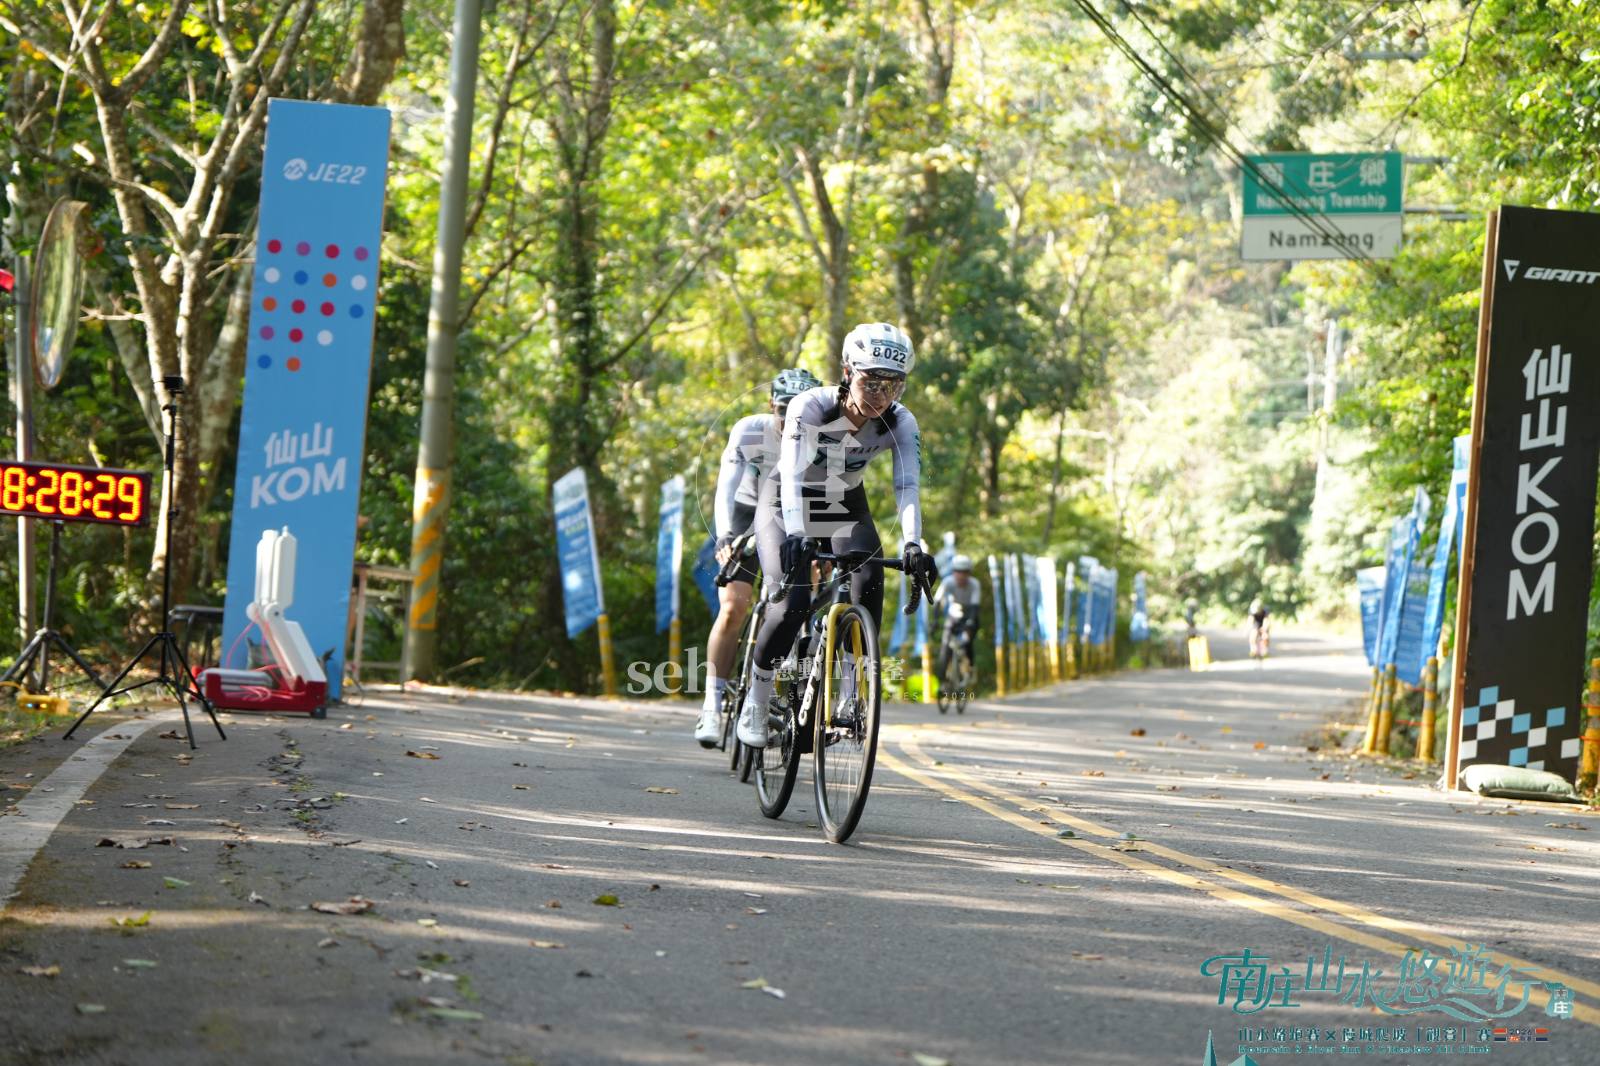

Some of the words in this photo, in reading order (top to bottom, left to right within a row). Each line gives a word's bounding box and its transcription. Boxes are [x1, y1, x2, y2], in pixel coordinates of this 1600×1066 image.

[308, 163, 367, 184] JE22
[1330, 191, 1387, 209] Township
[1524, 266, 1600, 284] GIANT
[264, 422, 333, 469] 仙山
[0, 467, 142, 521] 8:28:29
[250, 457, 347, 509] KOM
